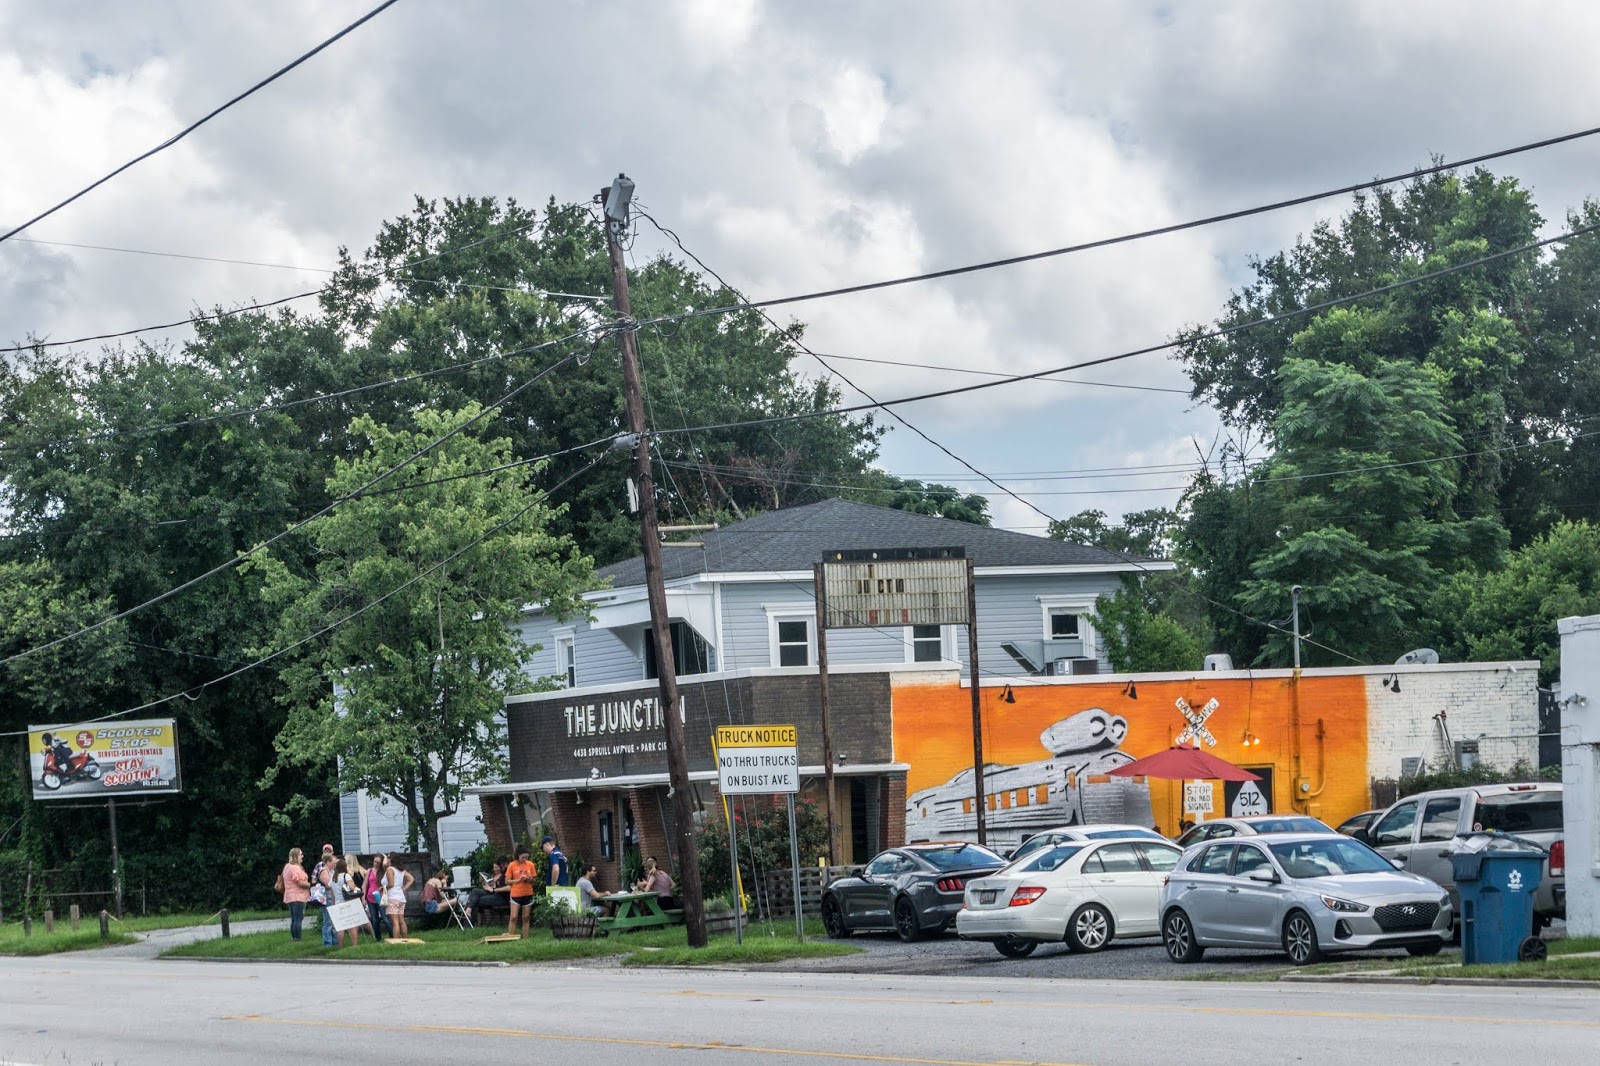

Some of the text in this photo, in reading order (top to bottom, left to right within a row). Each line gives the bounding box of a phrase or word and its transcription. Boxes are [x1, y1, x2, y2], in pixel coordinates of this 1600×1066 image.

[564, 695, 686, 737] THE JUNCTIN
[97, 727, 163, 739] SCOOTER
[719, 729, 795, 743] TRUCK NOTICE
[110, 738, 150, 749] STOP
[588, 746, 611, 757] SPRUILL
[641, 742, 657, 752] PARK
[115, 758, 144, 772] STAY
[720, 755, 796, 767] NO THRU TRUCKS
[104, 766, 159, 786] SCOOTIN'!
[727, 774, 792, 786] ON BUIST AVE.
[1186, 785, 1211, 795] STOP
[1239, 791, 1260, 807] 512
[1187, 802, 1211, 811] SIGNAL
